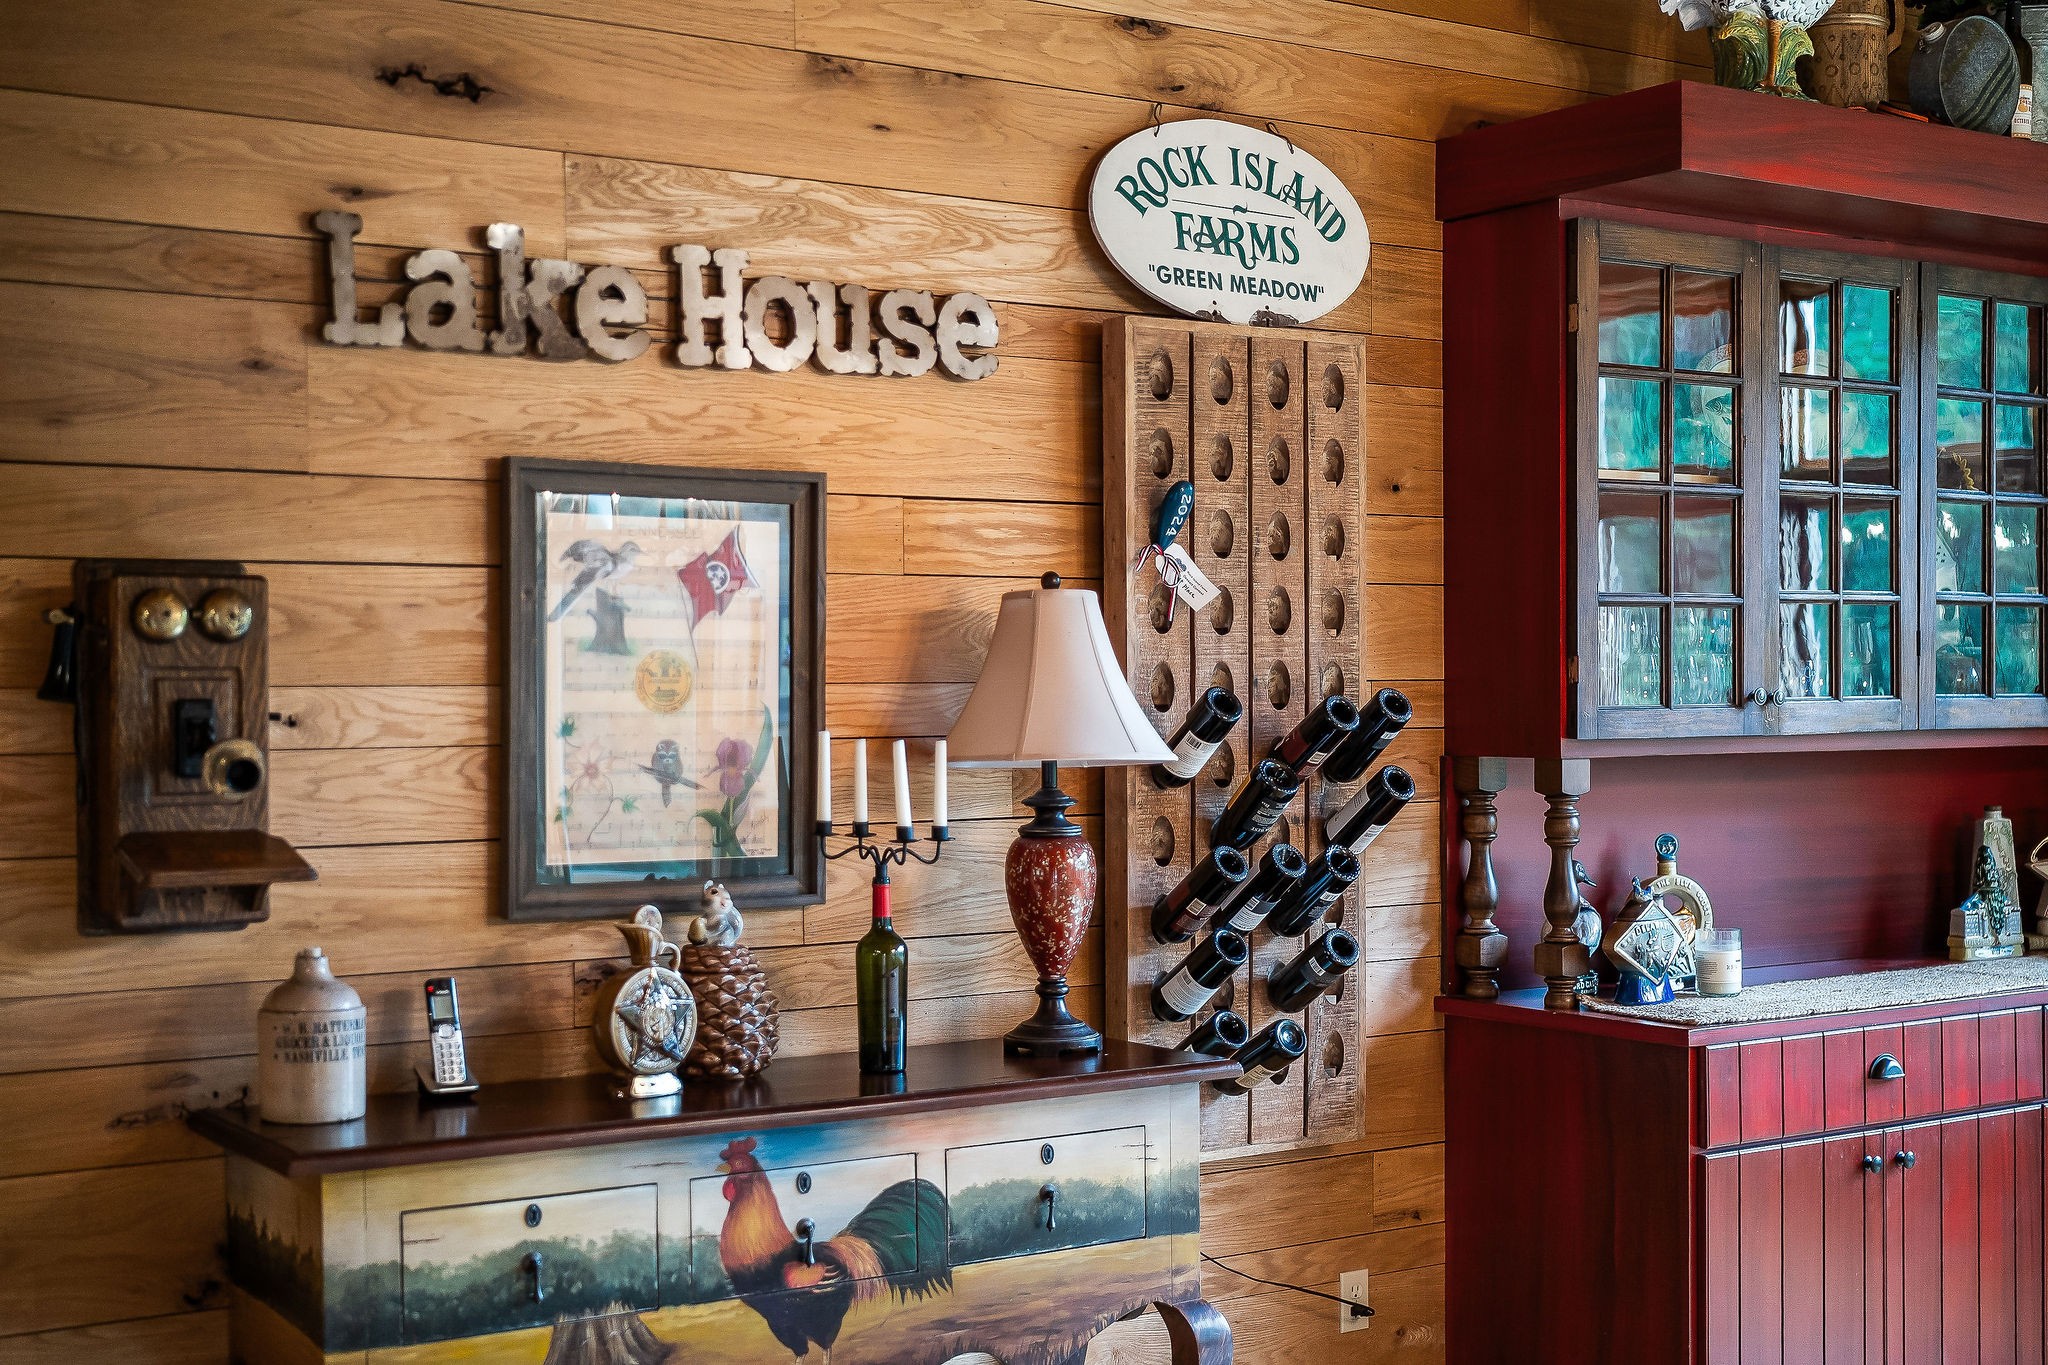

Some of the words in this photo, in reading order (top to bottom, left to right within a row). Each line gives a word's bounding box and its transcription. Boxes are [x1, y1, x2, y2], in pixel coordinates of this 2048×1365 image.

[1114, 145, 1218, 218] ROCK
[1227, 146, 1347, 243] ISLAND
[1170, 210, 1300, 271] FARMS
[313, 210, 652, 362] Lake
[671, 244, 1000, 381] House
[1148, 264, 1224, 291] "GREEN
[1230, 275, 1325, 303] MEADOW"
[1165, 494, 1192, 537] 2024
